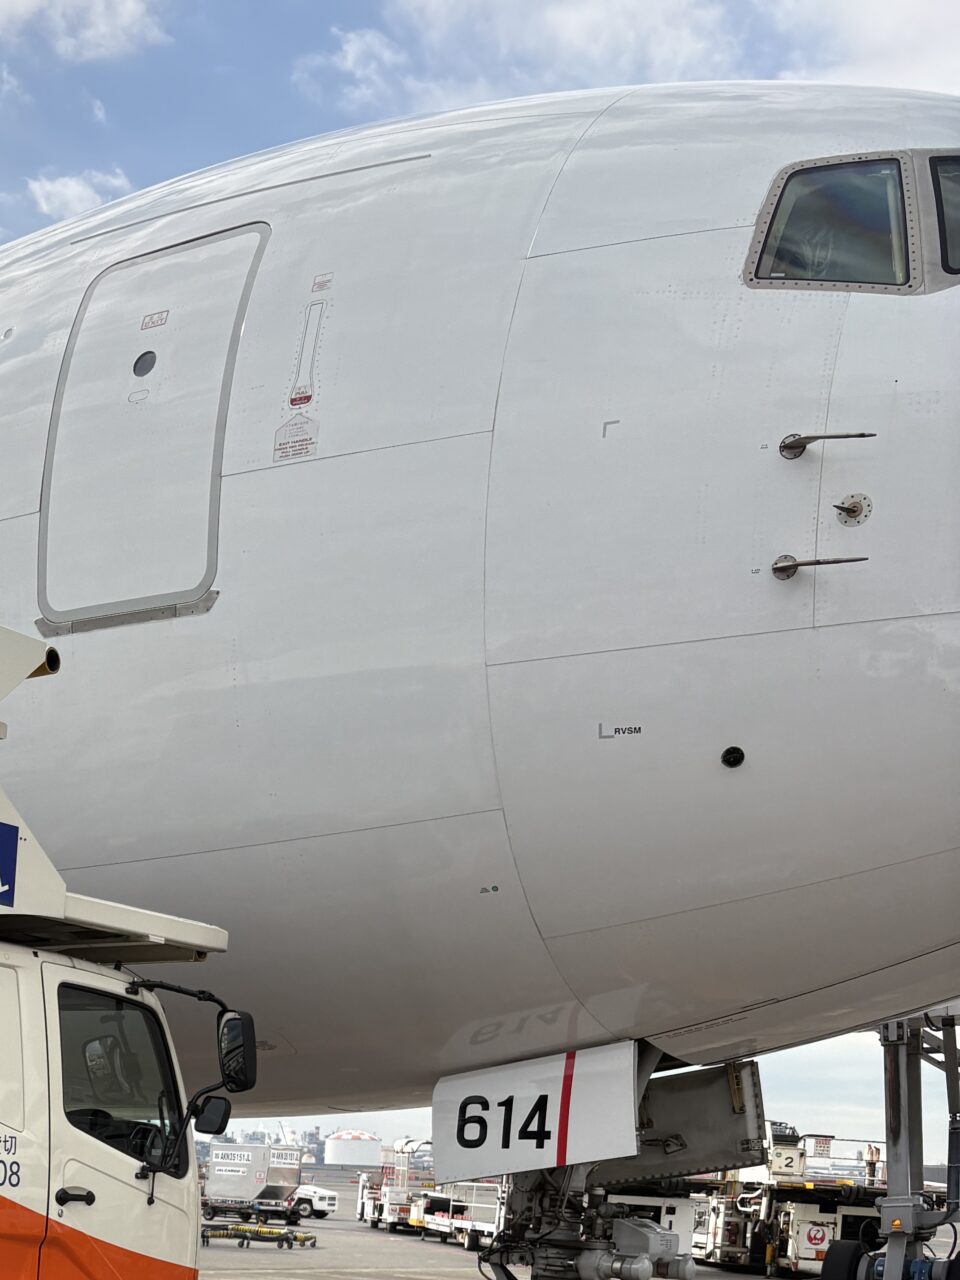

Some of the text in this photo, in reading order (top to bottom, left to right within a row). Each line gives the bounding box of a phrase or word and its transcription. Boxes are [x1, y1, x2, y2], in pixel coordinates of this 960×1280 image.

[614, 726, 642, 735] RVSM
[456, 1094, 552, 1150] 614
[784, 1156, 794, 1168] 2
